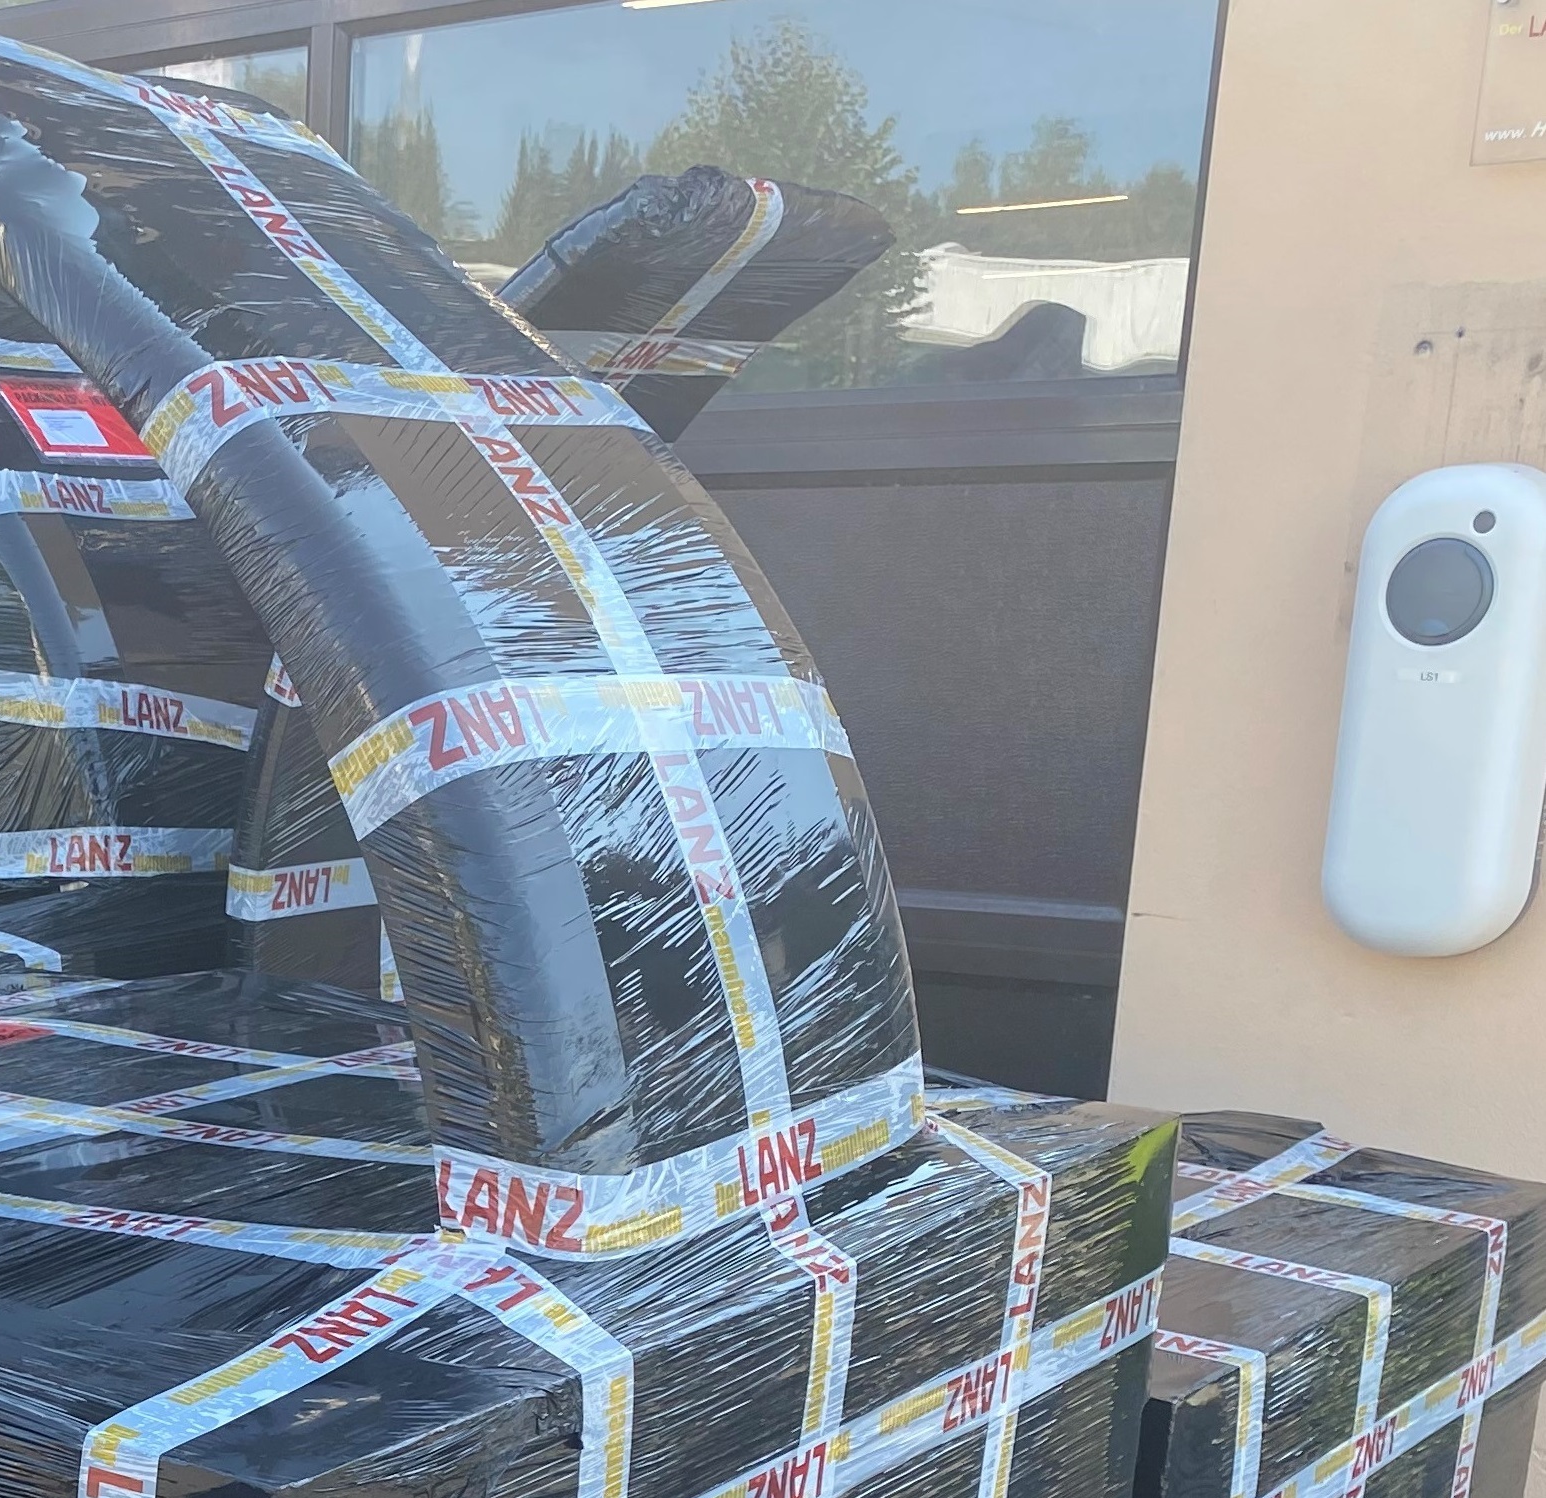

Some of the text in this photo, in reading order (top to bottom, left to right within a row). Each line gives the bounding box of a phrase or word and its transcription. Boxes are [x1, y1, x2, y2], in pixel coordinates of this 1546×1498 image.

[1498, 23, 1524, 37] Der
[212, 164, 324, 260] LANZ
[187, 362, 336, 428] LANZ
[462, 376, 583, 418] LANZ
[42, 473, 113, 514] LANZ
[121, 693, 185, 732] LANZ
[409, 684, 550, 772] LANZ
[680, 681, 782, 736] LANZ
[50, 834, 132, 874] LANZ
[271, 869, 330, 911] LANZ
[656, 752, 756, 1049] LANZ mannheim
[716, 1184, 740, 1217] Der
[738, 1119, 822, 1211] LANZ
[64, 1206, 208, 1236] LANZ
[437, 1160, 584, 1252] LANZ
[1009, 1175, 1047, 1317] LANZ
[1231, 1256, 1354, 1286] LANZ
[271, 1287, 418, 1364] LANZ
[942, 1351, 1014, 1433] LANZ
[1456, 1352, 1497, 1409] LANZ
[1351, 1420, 1394, 1479] LANZ
